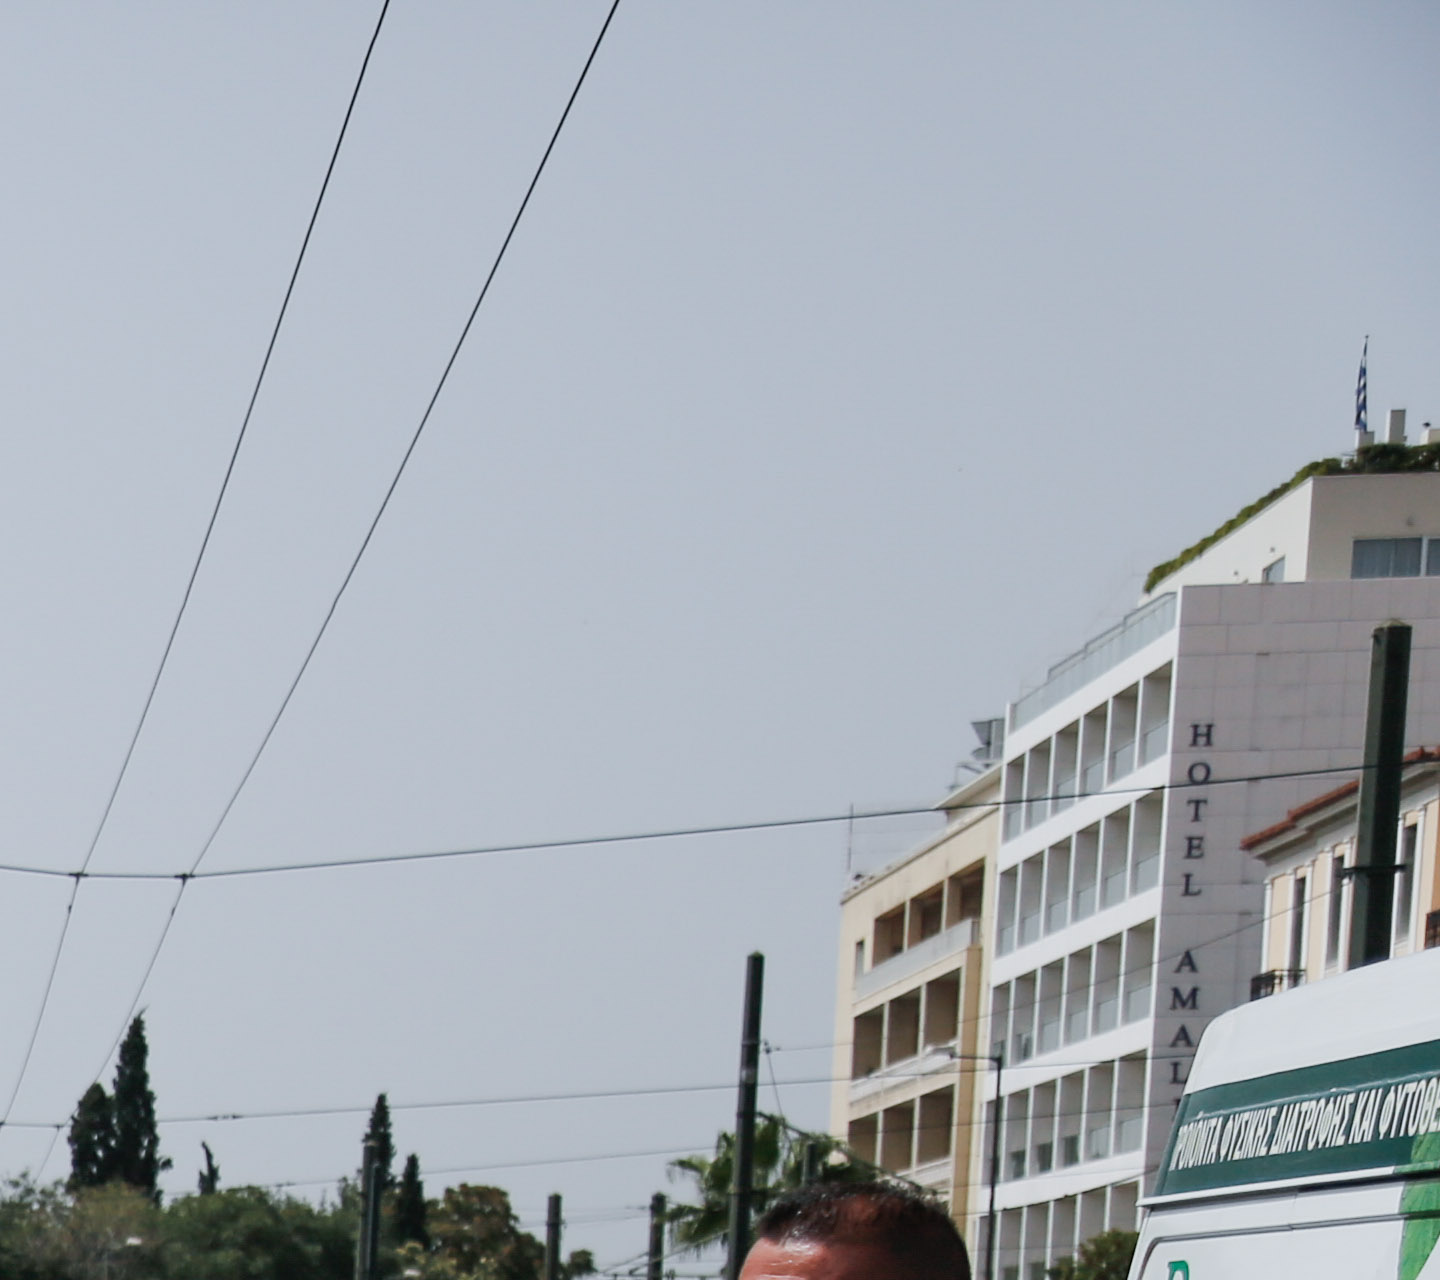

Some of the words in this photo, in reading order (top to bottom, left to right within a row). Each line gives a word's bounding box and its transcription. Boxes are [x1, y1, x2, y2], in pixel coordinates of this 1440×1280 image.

[1181, 723, 1215, 898] HOTEL
[1169, 949, 1200, 1112] AMAL
[1219, 1106, 1277, 1163] ΦΥΣΙΚΗΣ
[1268, 1092, 1356, 1156] ΔΙΑΤΡΟΦΗΣ
[1348, 1087, 1383, 1145] ΚΑΙ
[1379, 1076, 1440, 1140] ΦΥΤΟΘΕ
